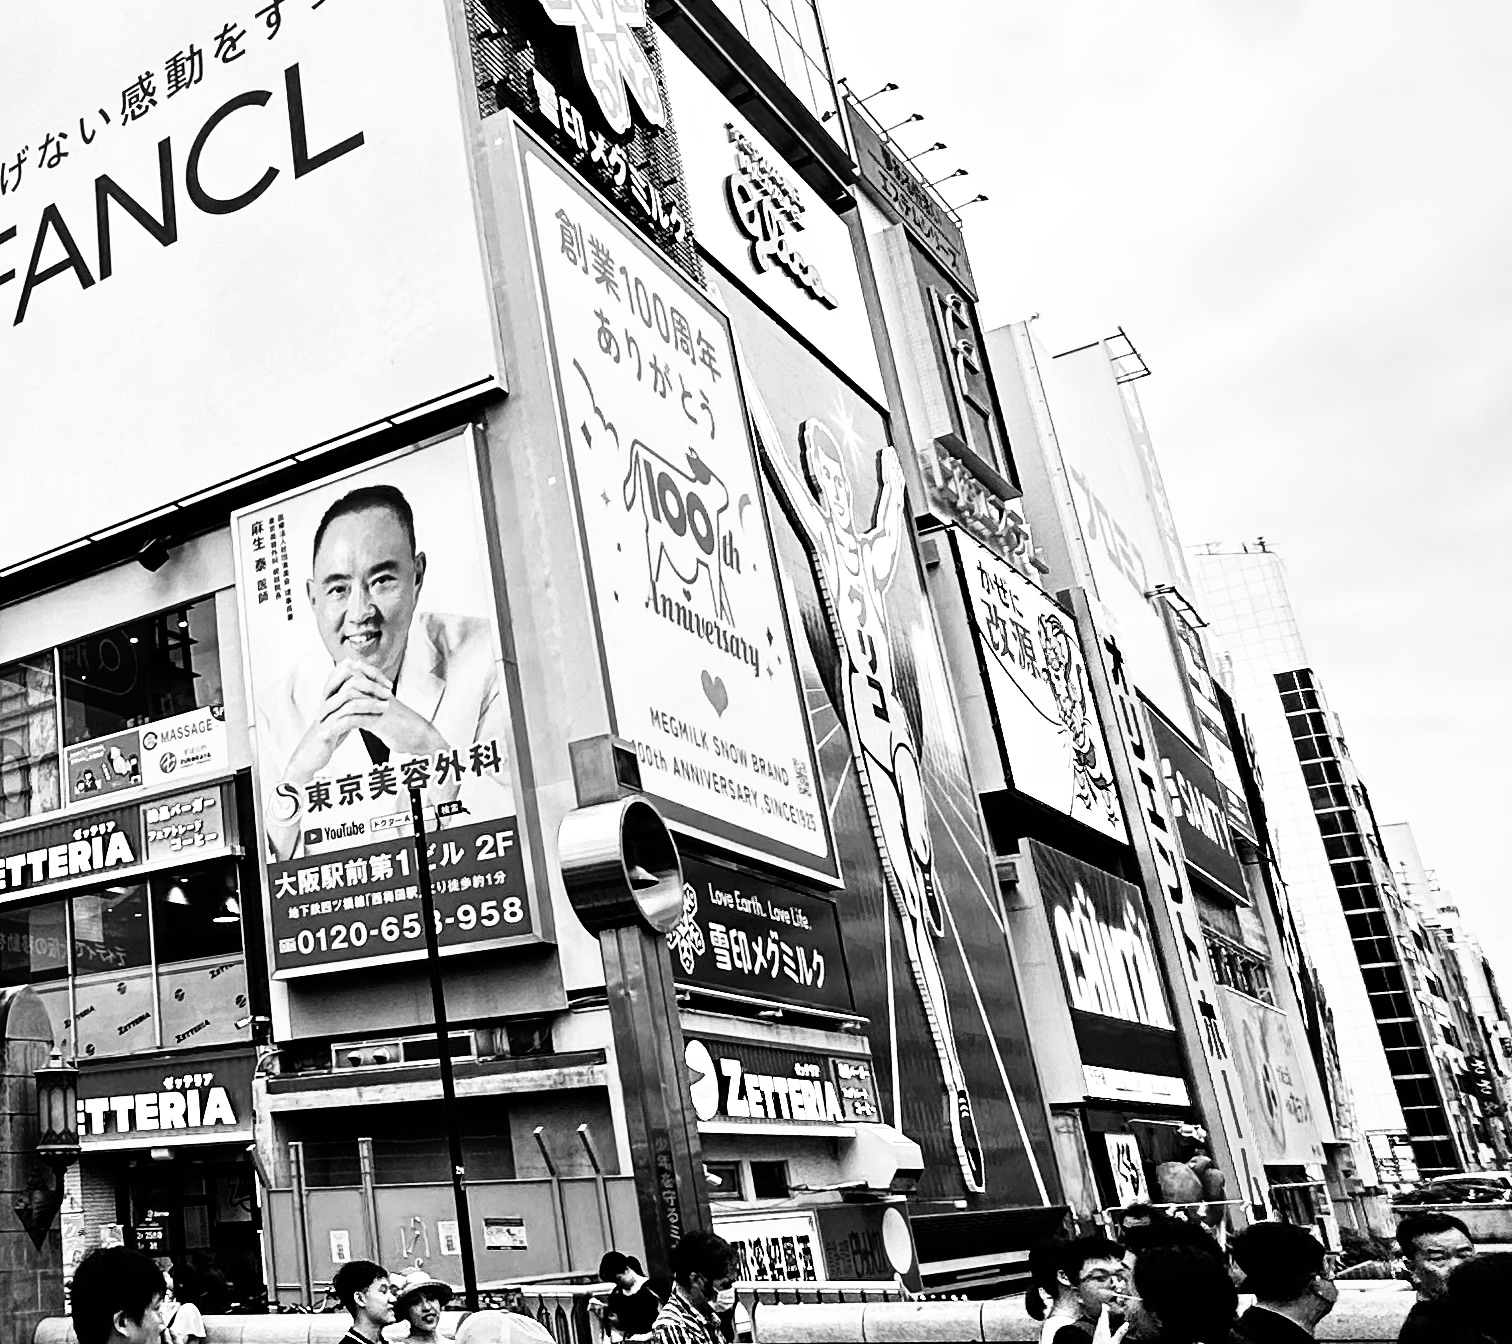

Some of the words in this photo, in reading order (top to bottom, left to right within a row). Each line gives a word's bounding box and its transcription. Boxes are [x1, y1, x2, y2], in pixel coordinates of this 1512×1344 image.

[555, 209, 721, 382] 創業100周年
[594, 307, 715, 440] ありがとう
[977, 560, 1024, 619] かぜに
[645, 579, 761, 678] Anniversary
[980, 597, 1041, 680] 改源
[160, 718, 213, 743] MASSAGE
[649, 706, 709, 751] MEGMILK
[712, 735, 748, 769] SNOW
[750, 753, 790, 787] BRAND
[305, 740, 502, 814] 東京美容外科
[638, 740, 668, 773] 00th
[672, 756, 759, 808] ANNIVERSARY
[170, 832, 219, 851] コーヒー
[324, 821, 365, 841] YouTube
[475, 830, 514, 861] 2F
[708, 883, 734, 908] Love
[768, 900, 791, 924] Love
[708, 922, 825, 988] 雪印メグミルク
[117, 1012, 151, 1036] ZETTERIA
[175, 1019, 211, 1044] ZETTERIA
[720, 1058, 845, 1122] ZETTERIA
